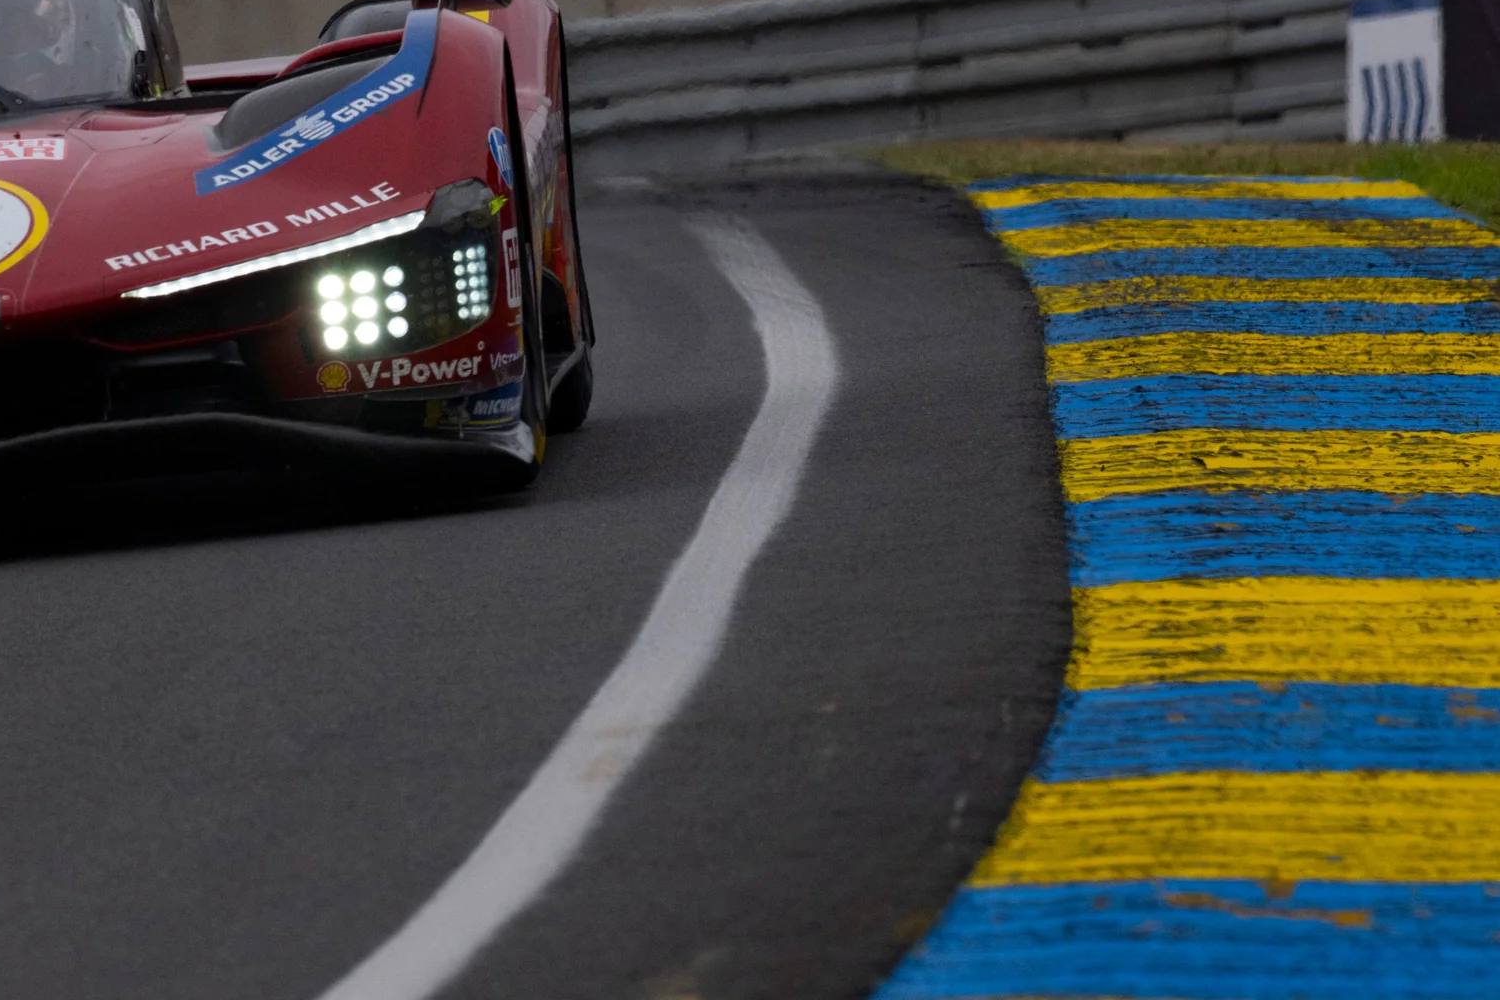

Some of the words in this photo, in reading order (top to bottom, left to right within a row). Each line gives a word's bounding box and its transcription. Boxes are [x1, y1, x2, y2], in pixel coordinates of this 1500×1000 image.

[213, 138, 306, 188] ADLER
[331, 73, 416, 124] GROUP
[104, 220, 280, 270] RICHARD
[285, 181, 401, 227] MILLE
[358, 356, 483, 389] V-Power
